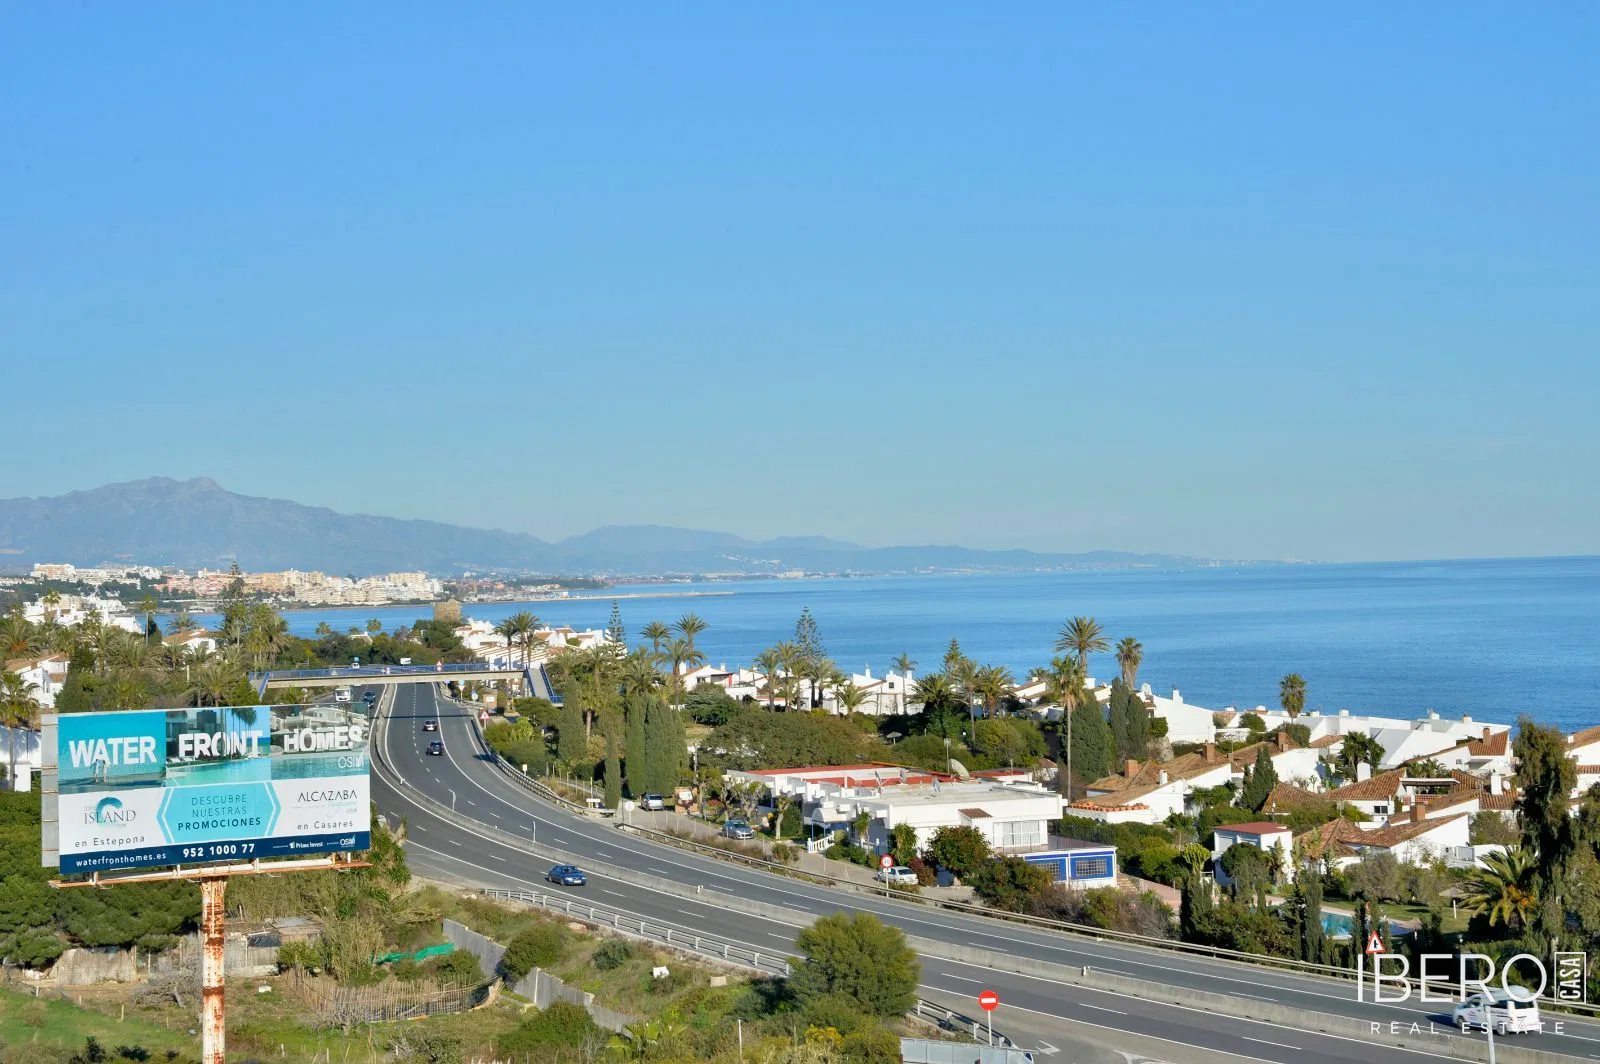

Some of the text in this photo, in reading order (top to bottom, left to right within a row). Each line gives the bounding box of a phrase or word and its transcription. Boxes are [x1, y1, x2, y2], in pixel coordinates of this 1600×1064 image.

[178, 730, 263, 760] FRONT
[283, 726, 363, 753] HOMES
[68, 736, 157, 768] WATER
[191, 794, 247, 806] DESCUBRE
[298, 789, 357, 802] ALCAZABA
[84, 810, 137, 824] ISLAND
[192, 806, 247, 818] NUESTRAS
[178, 817, 261, 831] PROMOCIONES
[313, 821, 353, 829] Casares
[93, 836, 145, 846] Estepona
[183, 843, 255, 858] 952 1000 77
[76, 852, 167, 867] waterfronthomes.es
